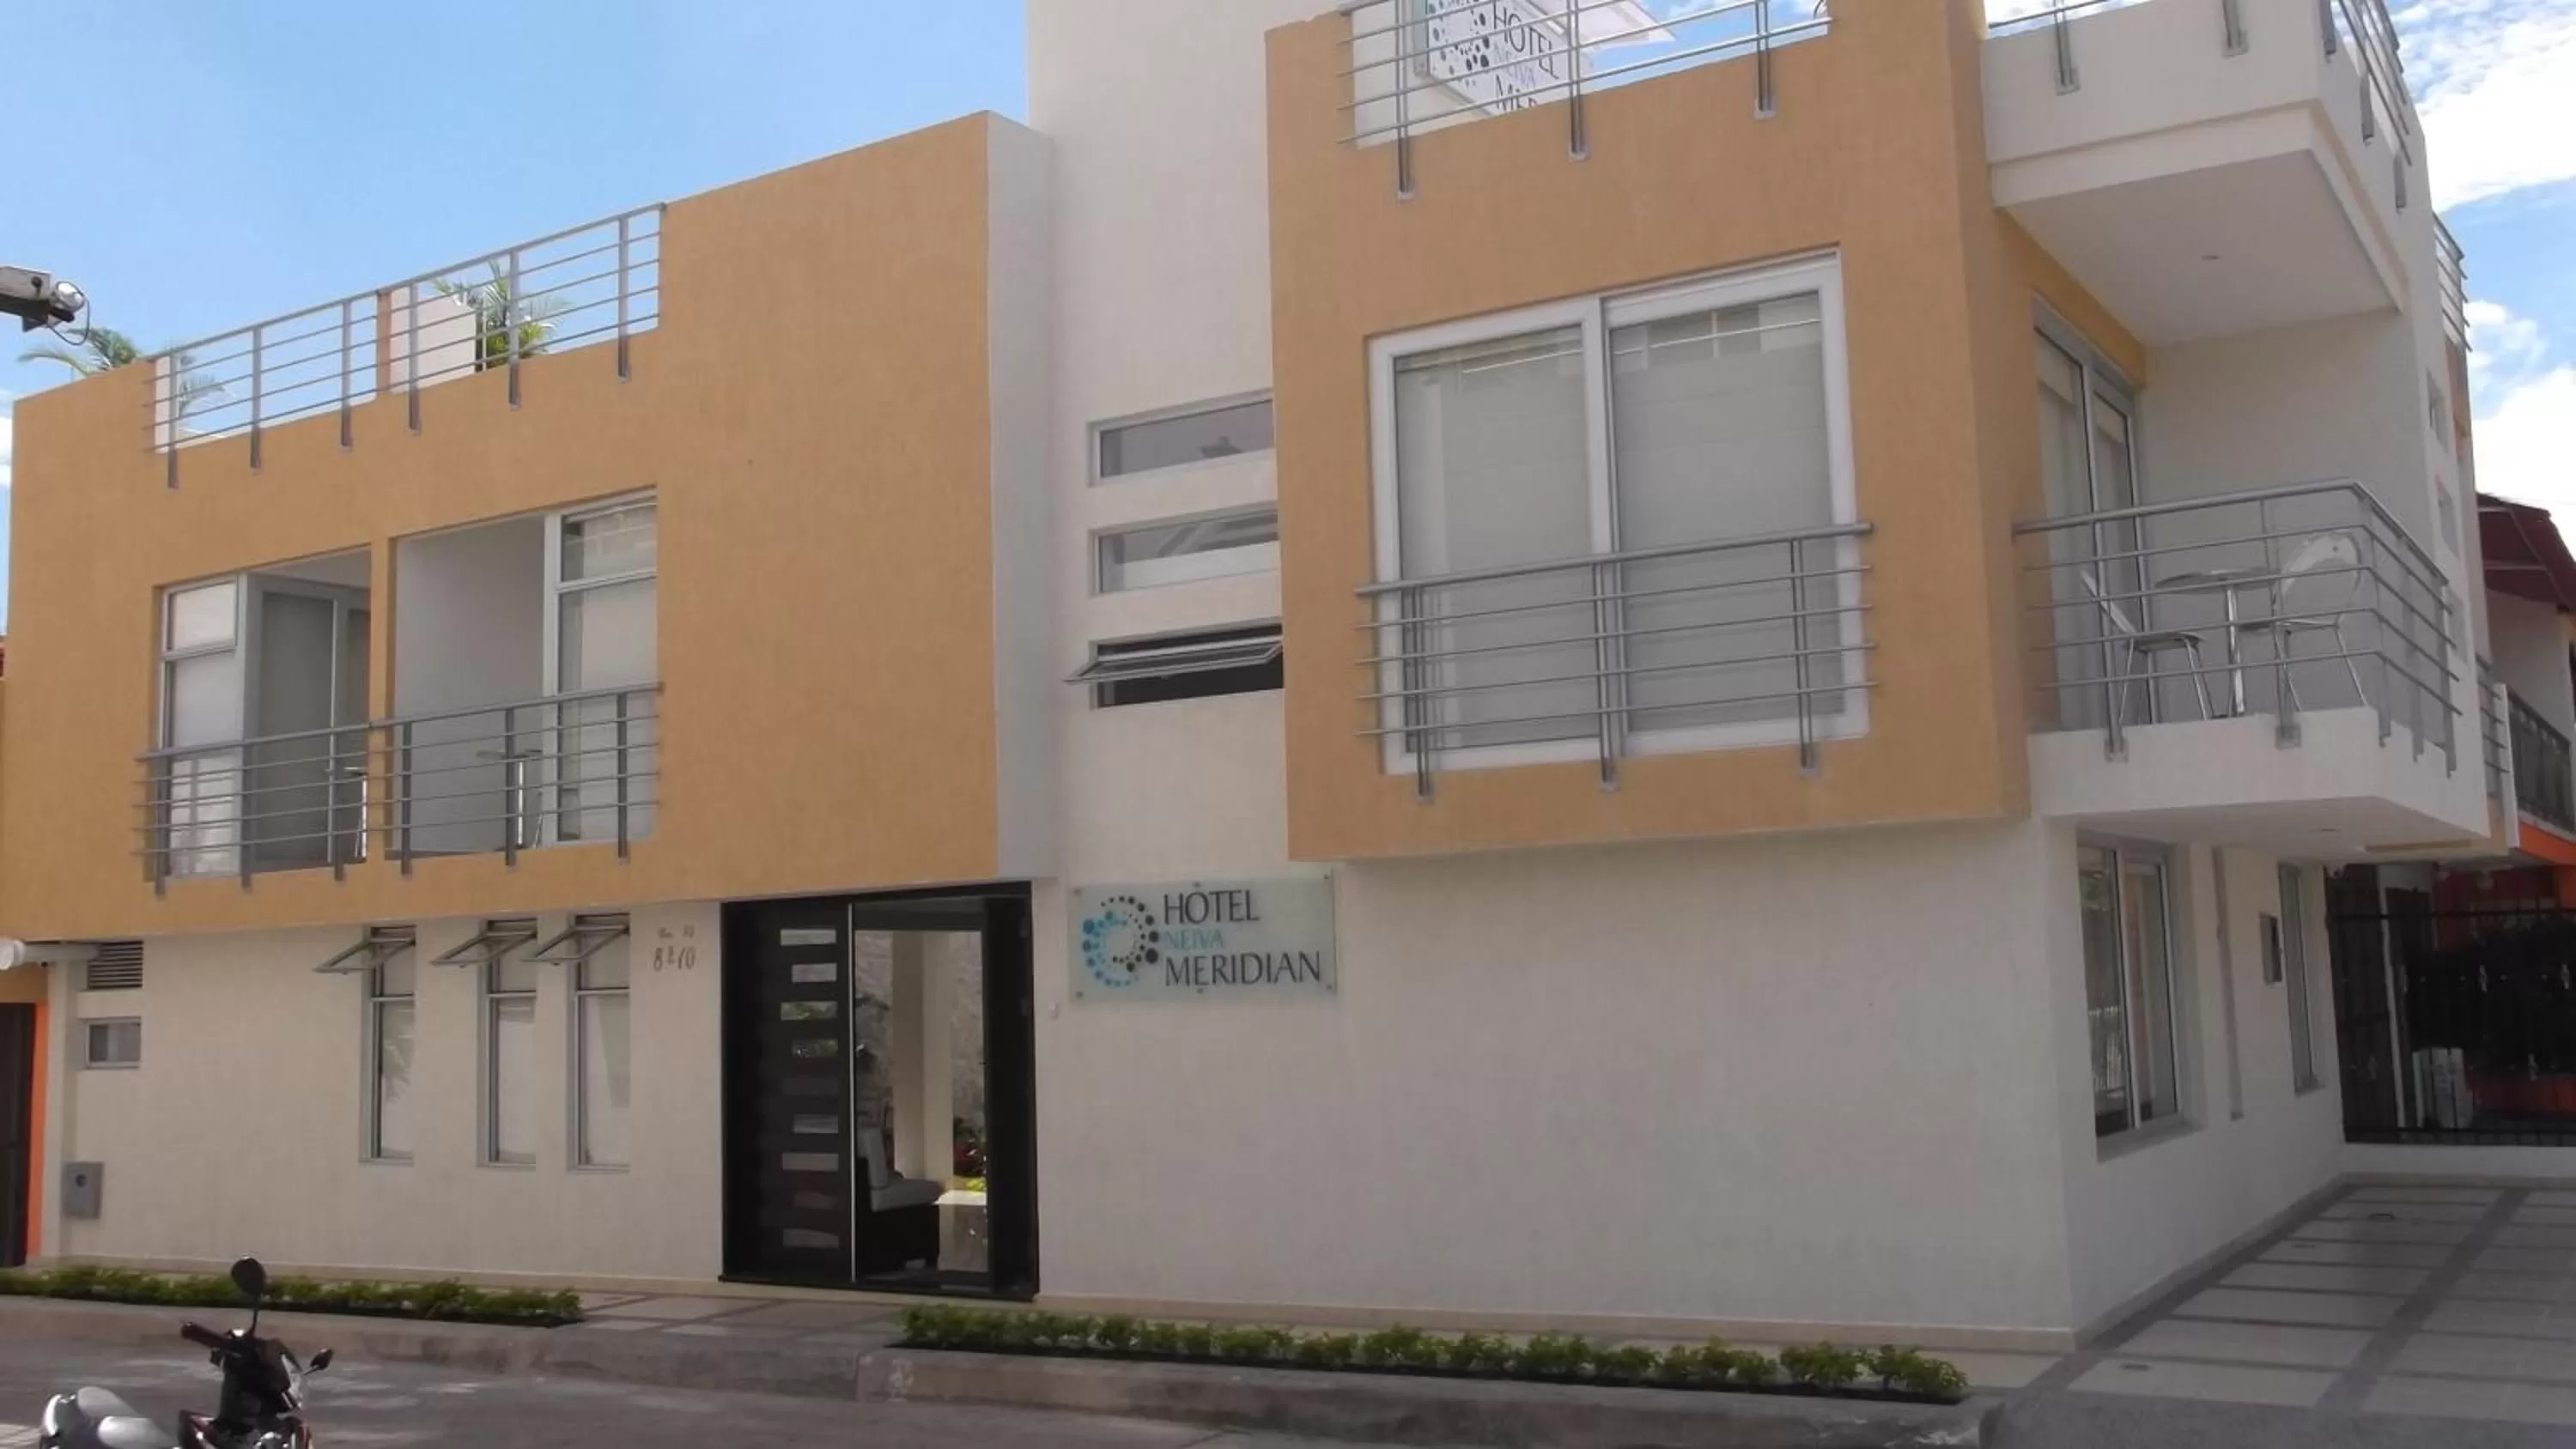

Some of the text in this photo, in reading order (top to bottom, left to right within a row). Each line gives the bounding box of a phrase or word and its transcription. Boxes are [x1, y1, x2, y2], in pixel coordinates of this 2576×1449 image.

[1493, 1, 1559, 80] HOTEL
[1163, 889, 1260, 925] HOTEL
[1164, 928, 1225, 950] NEIVA
[1165, 951, 1321, 987] MERIDIAN
